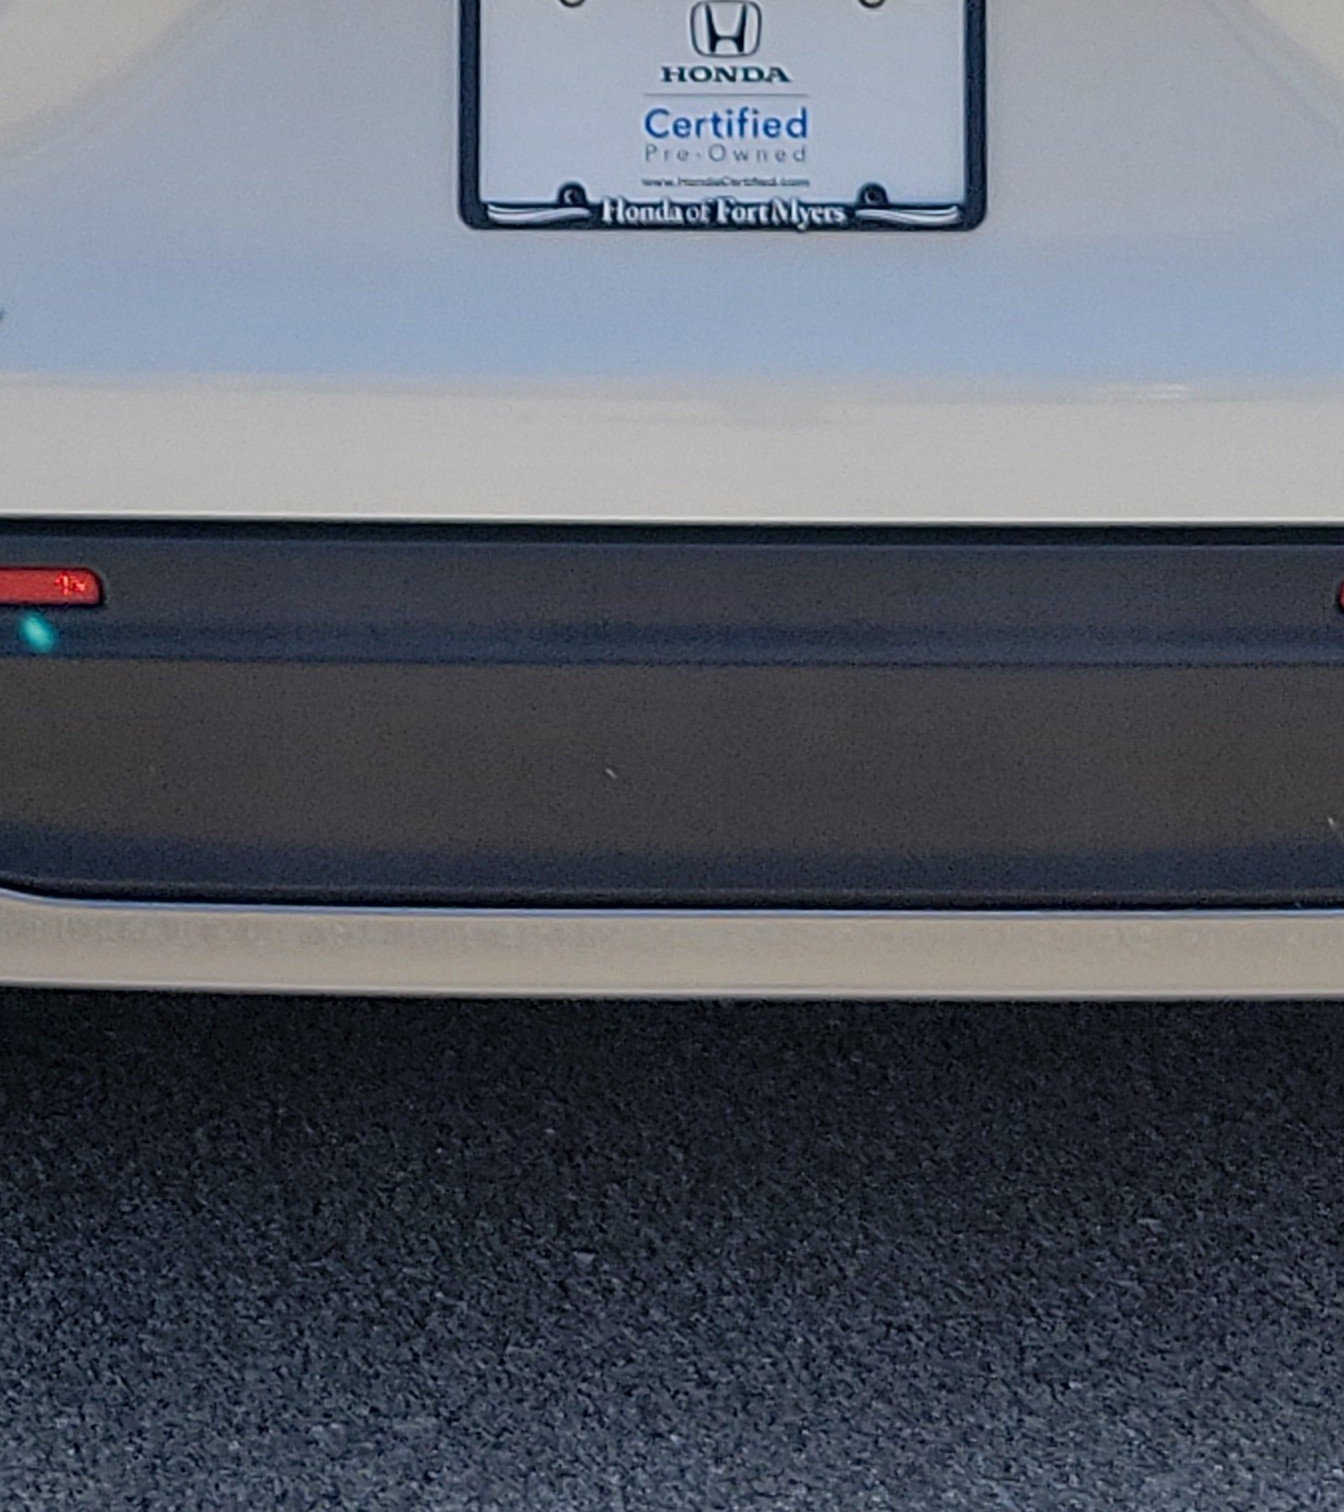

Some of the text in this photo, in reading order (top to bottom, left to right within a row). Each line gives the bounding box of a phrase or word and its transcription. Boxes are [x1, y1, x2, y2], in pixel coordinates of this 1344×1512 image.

[660, 65, 792, 84] HONDA
[643, 106, 809, 139] Certified
[644, 143, 807, 163] Pre-Owned
[601, 196, 848, 231] Honda of Fort Myers
